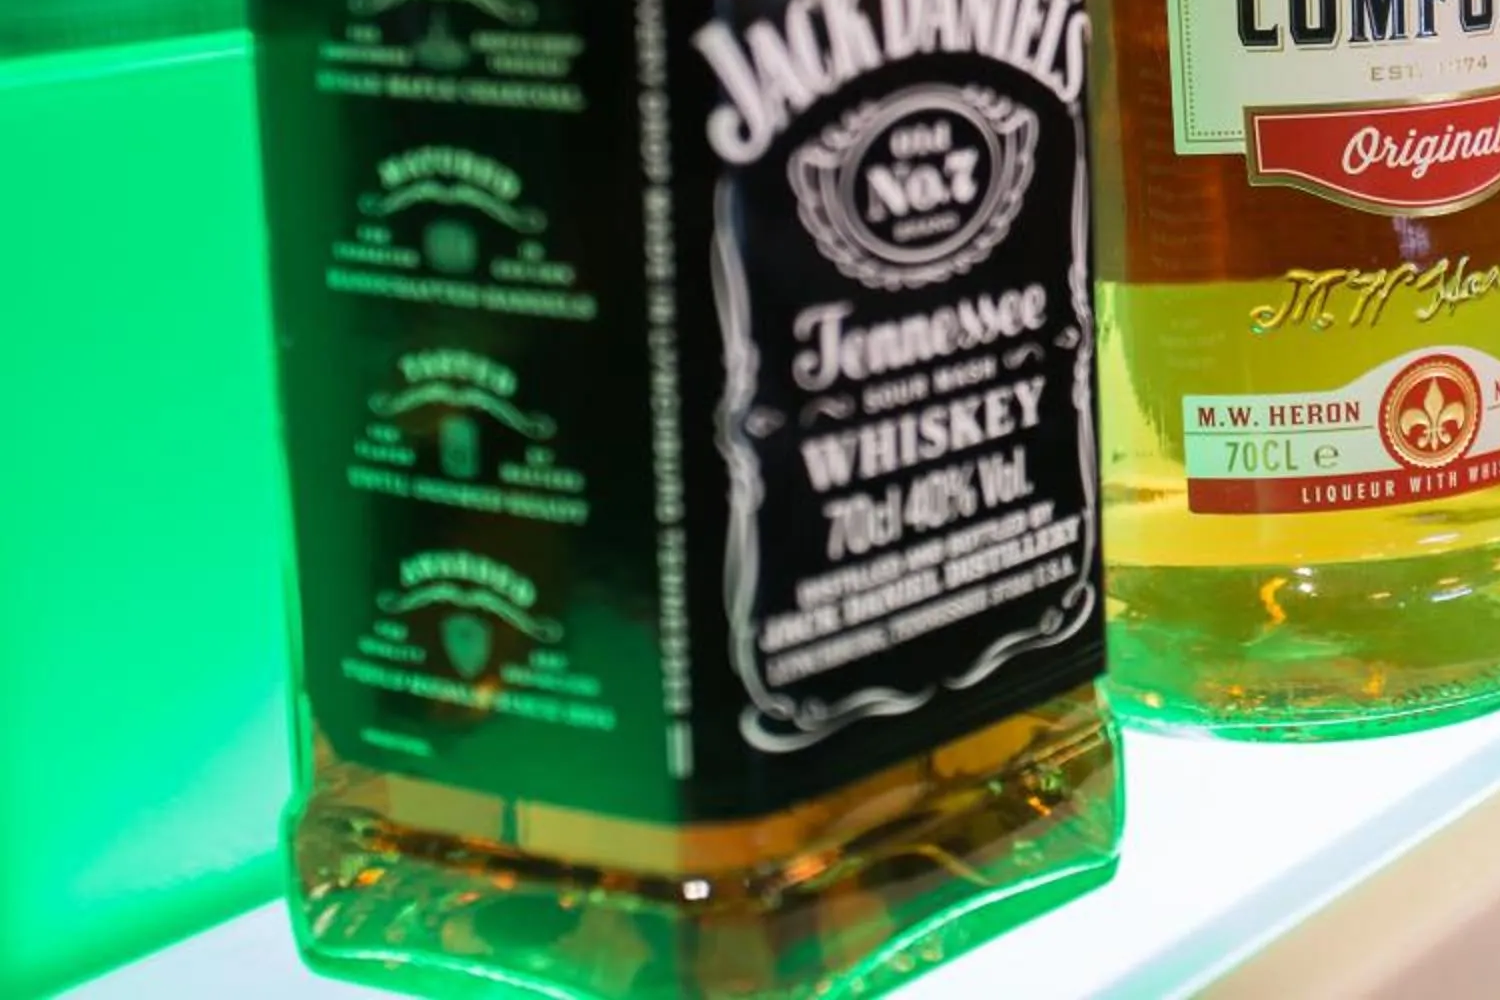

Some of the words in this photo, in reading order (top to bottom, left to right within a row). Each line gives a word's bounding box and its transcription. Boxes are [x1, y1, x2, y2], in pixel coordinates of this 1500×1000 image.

[792, 283, 1047, 391] Tennessee
[1268, 401, 1361, 426] HERON
[800, 375, 1046, 493] WHISKEY
[1225, 440, 1298, 473] 70CL
[1302, 478, 1396, 504] LIQUEUR
[1410, 465, 1458, 493] WITH
